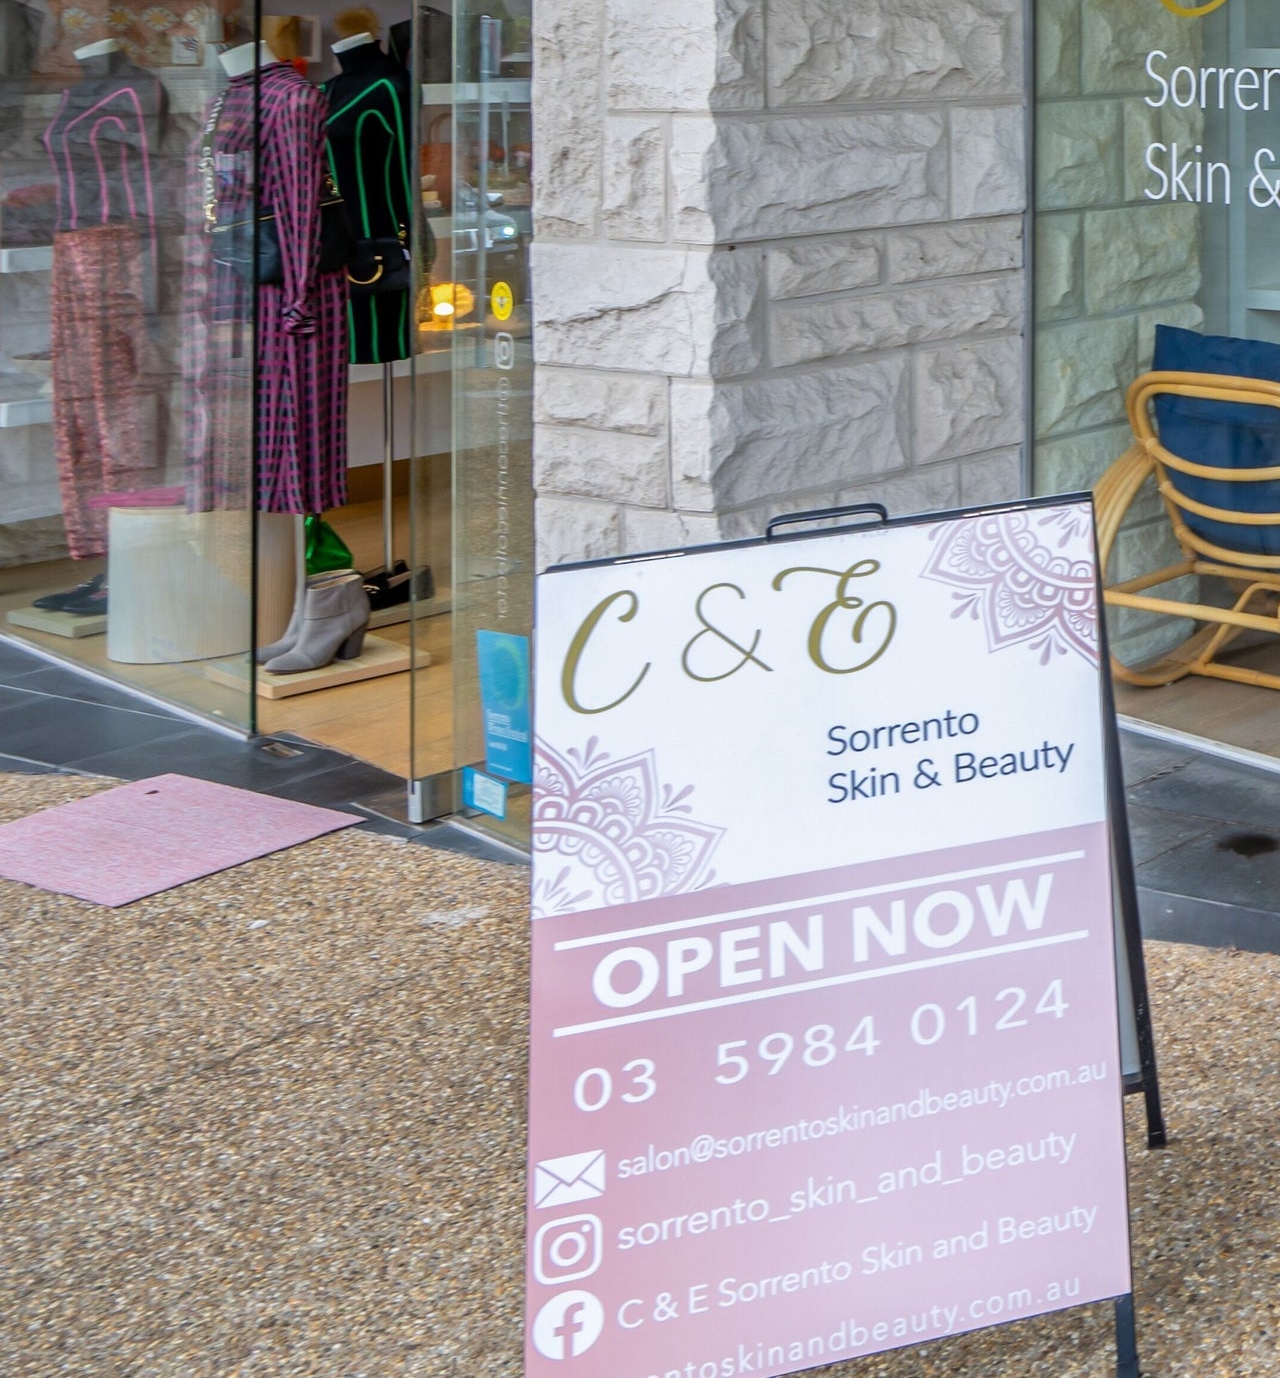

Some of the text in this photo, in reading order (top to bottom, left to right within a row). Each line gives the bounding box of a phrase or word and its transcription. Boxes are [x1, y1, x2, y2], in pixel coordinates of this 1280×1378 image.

[1143, 142, 1231, 205] Skin
[560, 558, 898, 716] C & E
[826, 708, 980, 756] Sorrento
[826, 738, 1076, 805] Skin & Beauty
[591, 872, 1055, 1009] OPEN NOW
[572, 977, 1070, 1114] 03 5984 0124
[616, 1059, 1108, 1179] salon@sorrentoskinandbeauty.com.au
[616, 1129, 1079, 1251] sorrento_skin_and_beauty
[617, 1203, 1099, 1331] C & E Sorrento Skin and Beauty
